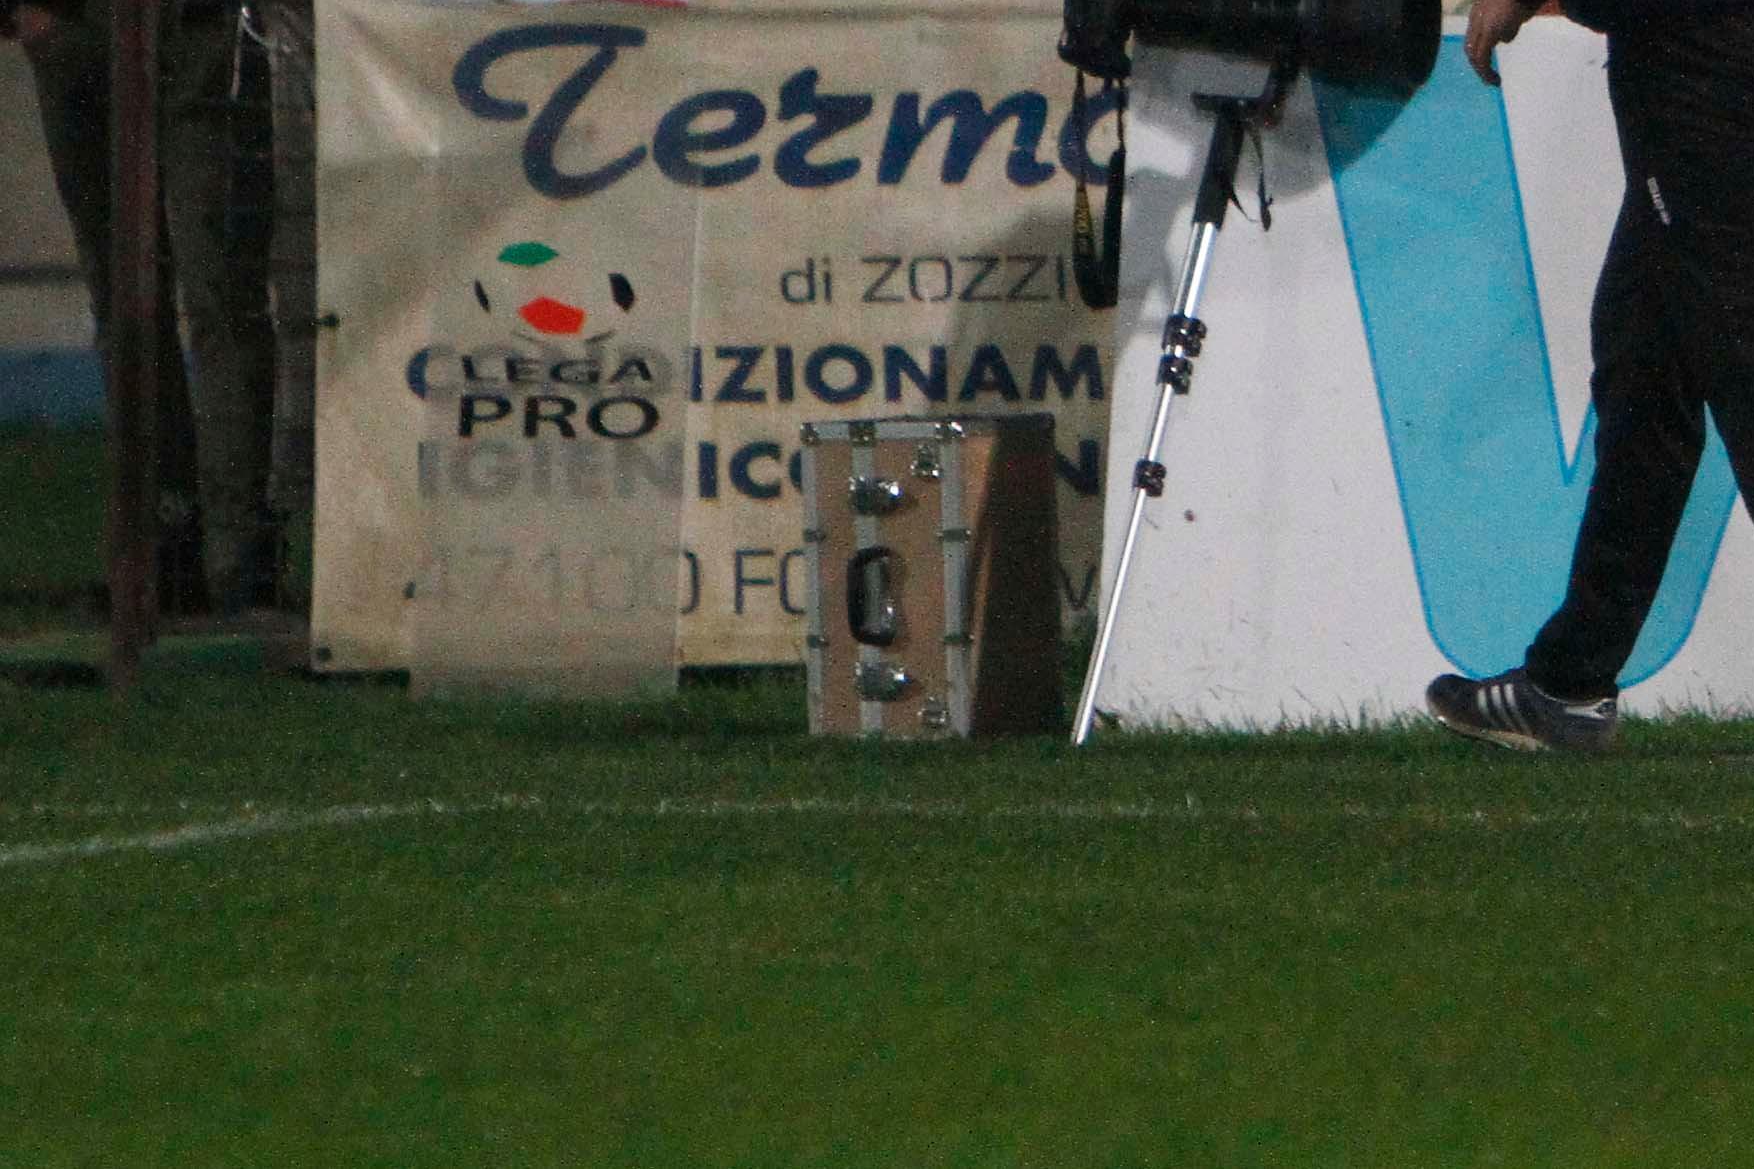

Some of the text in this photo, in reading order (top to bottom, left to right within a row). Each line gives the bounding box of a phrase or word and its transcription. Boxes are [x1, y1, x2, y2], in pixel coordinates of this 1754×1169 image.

[780, 255, 832, 304] di
[461, 354, 654, 384] LEGA
[458, 394, 660, 439] PRO
[416, 439, 804, 501] IGIENIC
